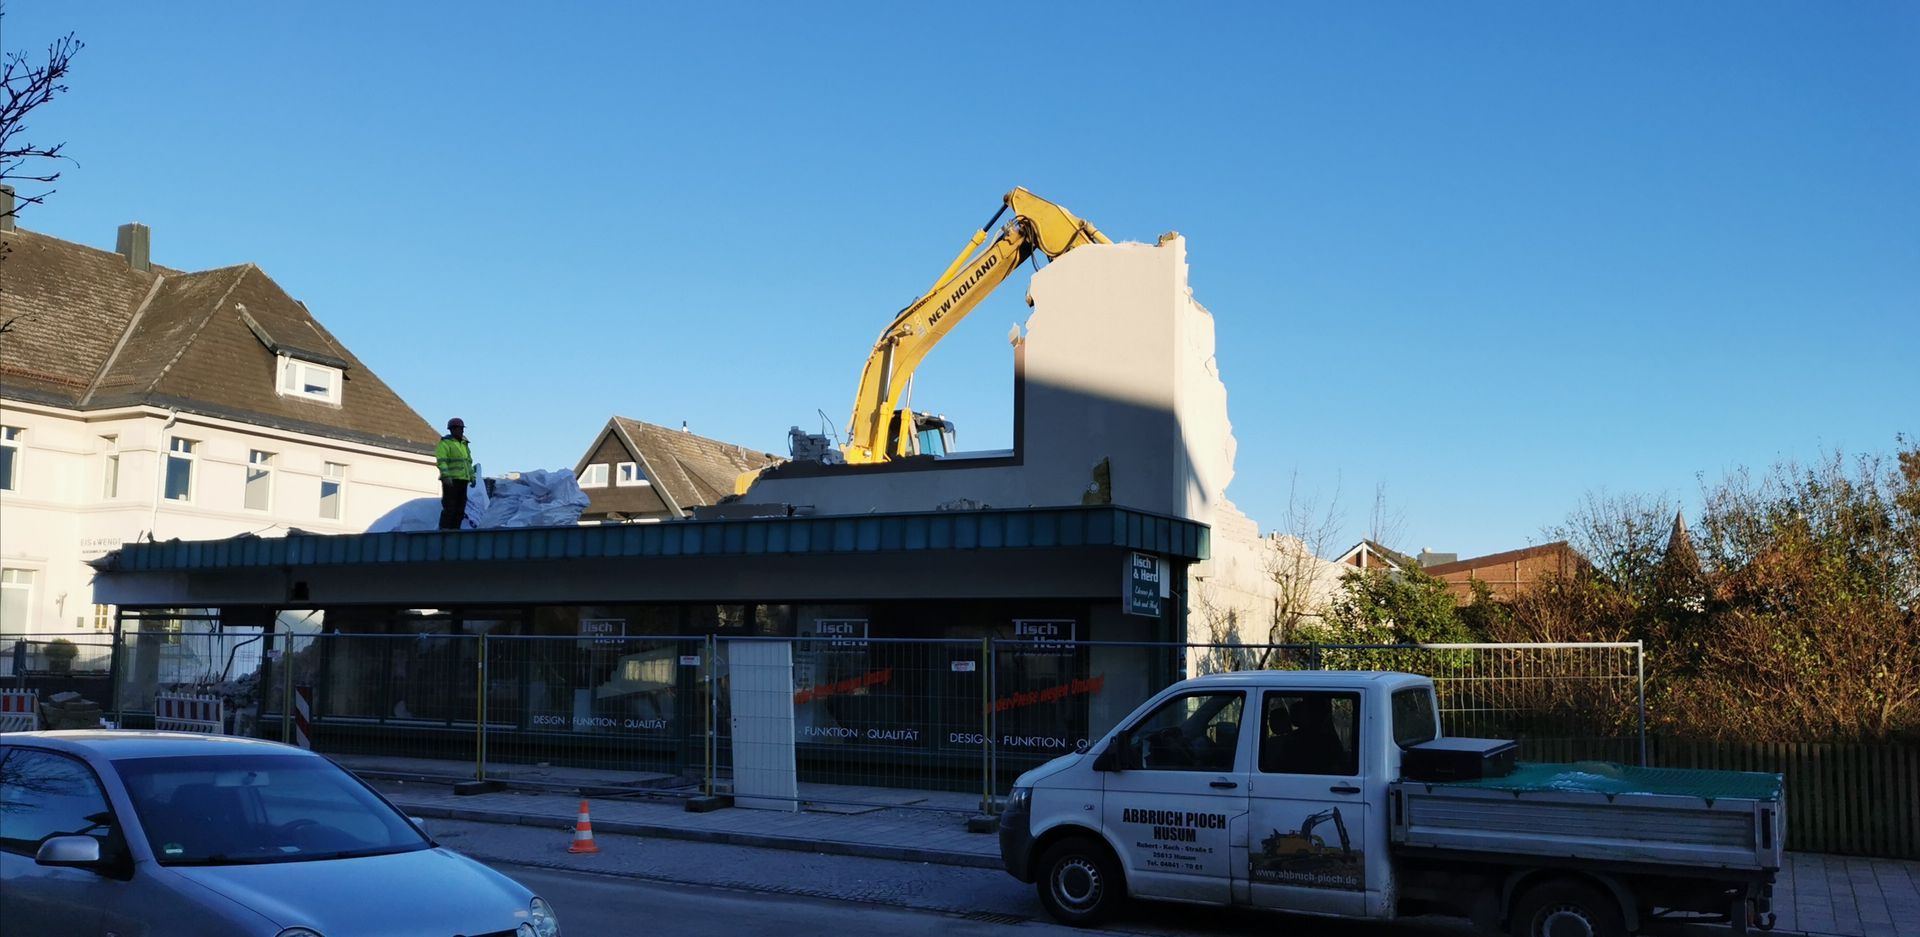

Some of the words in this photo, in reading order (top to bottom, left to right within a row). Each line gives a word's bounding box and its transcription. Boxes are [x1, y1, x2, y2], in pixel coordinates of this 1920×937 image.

[928, 300, 951, 326] NEW
[951, 254, 998, 304] HOLLAND
[1133, 552, 1151, 569] Tisch
[1133, 568, 1140, 579] &
[1141, 559, 1158, 583] Herd
[814, 618, 854, 634] Tisch
[1011, 618, 1058, 635] Tisch
[533, 715, 566, 725] DESIGN
[572, 717, 617, 727] FUNKTION
[624, 717, 667, 729] QUALITÄT
[804, 726, 858, 738] FUNKTION
[867, 728, 919, 741] QUALITÄT
[1003, 736, 1066, 748] FUNKTION
[1123, 808, 1182, 826] ABBRUCH
[1186, 812, 1226, 829] PIOCH
[1153, 826, 1196, 842] HUSUM
[1255, 869, 1358, 885] www.abbruch-pioch.de
